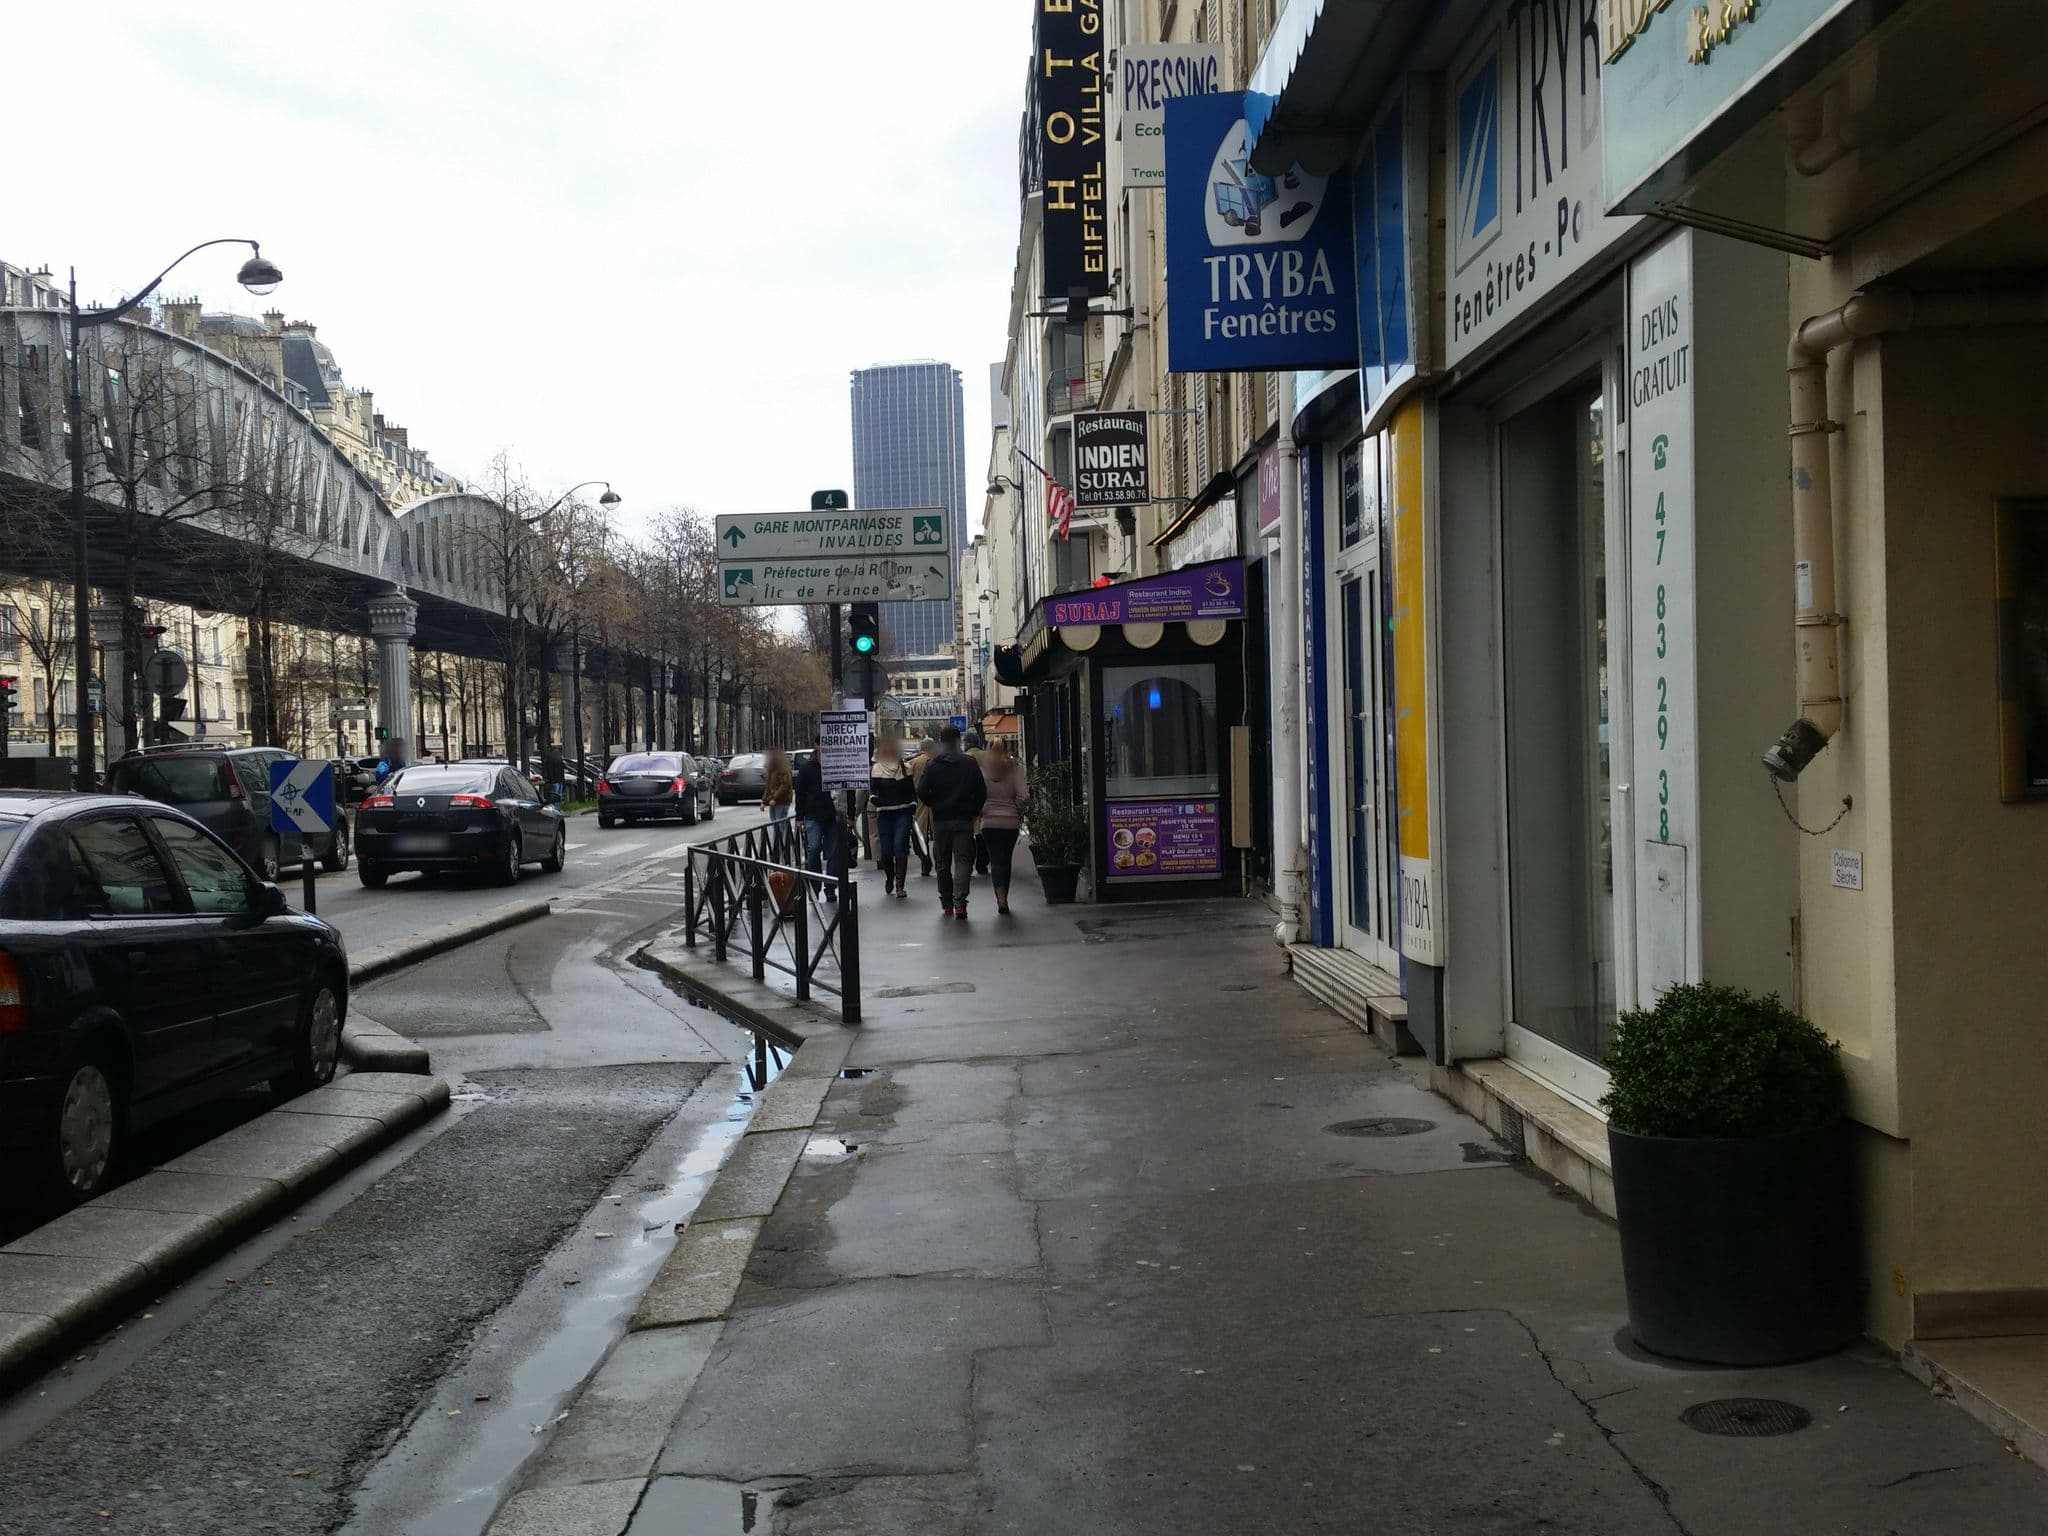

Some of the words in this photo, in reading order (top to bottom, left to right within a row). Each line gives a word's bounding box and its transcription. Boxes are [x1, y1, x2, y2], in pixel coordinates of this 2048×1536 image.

[1124, 55, 1219, 111] PRESSING
[1081, 51, 1101, 146] VILLA
[1083, 162, 1103, 273] EIFFEL
[1204, 248, 1335, 302] TRYBA
[1204, 302, 1336, 340] Fenêtres
[1641, 295, 1679, 352] DEVIS
[1633, 344, 1689, 408] GRATUIT
[1078, 416, 1144, 438] Restaurant
[1078, 444, 1145, 469] INDIEN
[1080, 471, 1145, 489] SURAJ
[825, 494, 834, 506] 4
[754, 521, 789, 534] GARE
[793, 517, 903, 532] MONTPARNASSE
[819, 534, 903, 549] INVALIDES
[764, 565, 830, 579] Préfecture
[835, 564, 850, 577] de
[853, 564, 865, 576] la
[1301, 456, 1313, 684] REPASSAGE
[797, 585, 814, 598] de
[827, 584, 879, 597] France
[1129, 590, 1168, 598] Restaurant
[1055, 601, 1120, 622] SURAJ
[826, 724, 858, 735] DIRECT
[821, 735, 868, 746] FABRICANT
[1111, 807, 1150, 816] Restaurant
[1150, 806, 1173, 814] Indien
[1833, 852, 1859, 869] Colonne
[1401, 869, 1431, 931] TRYBA
